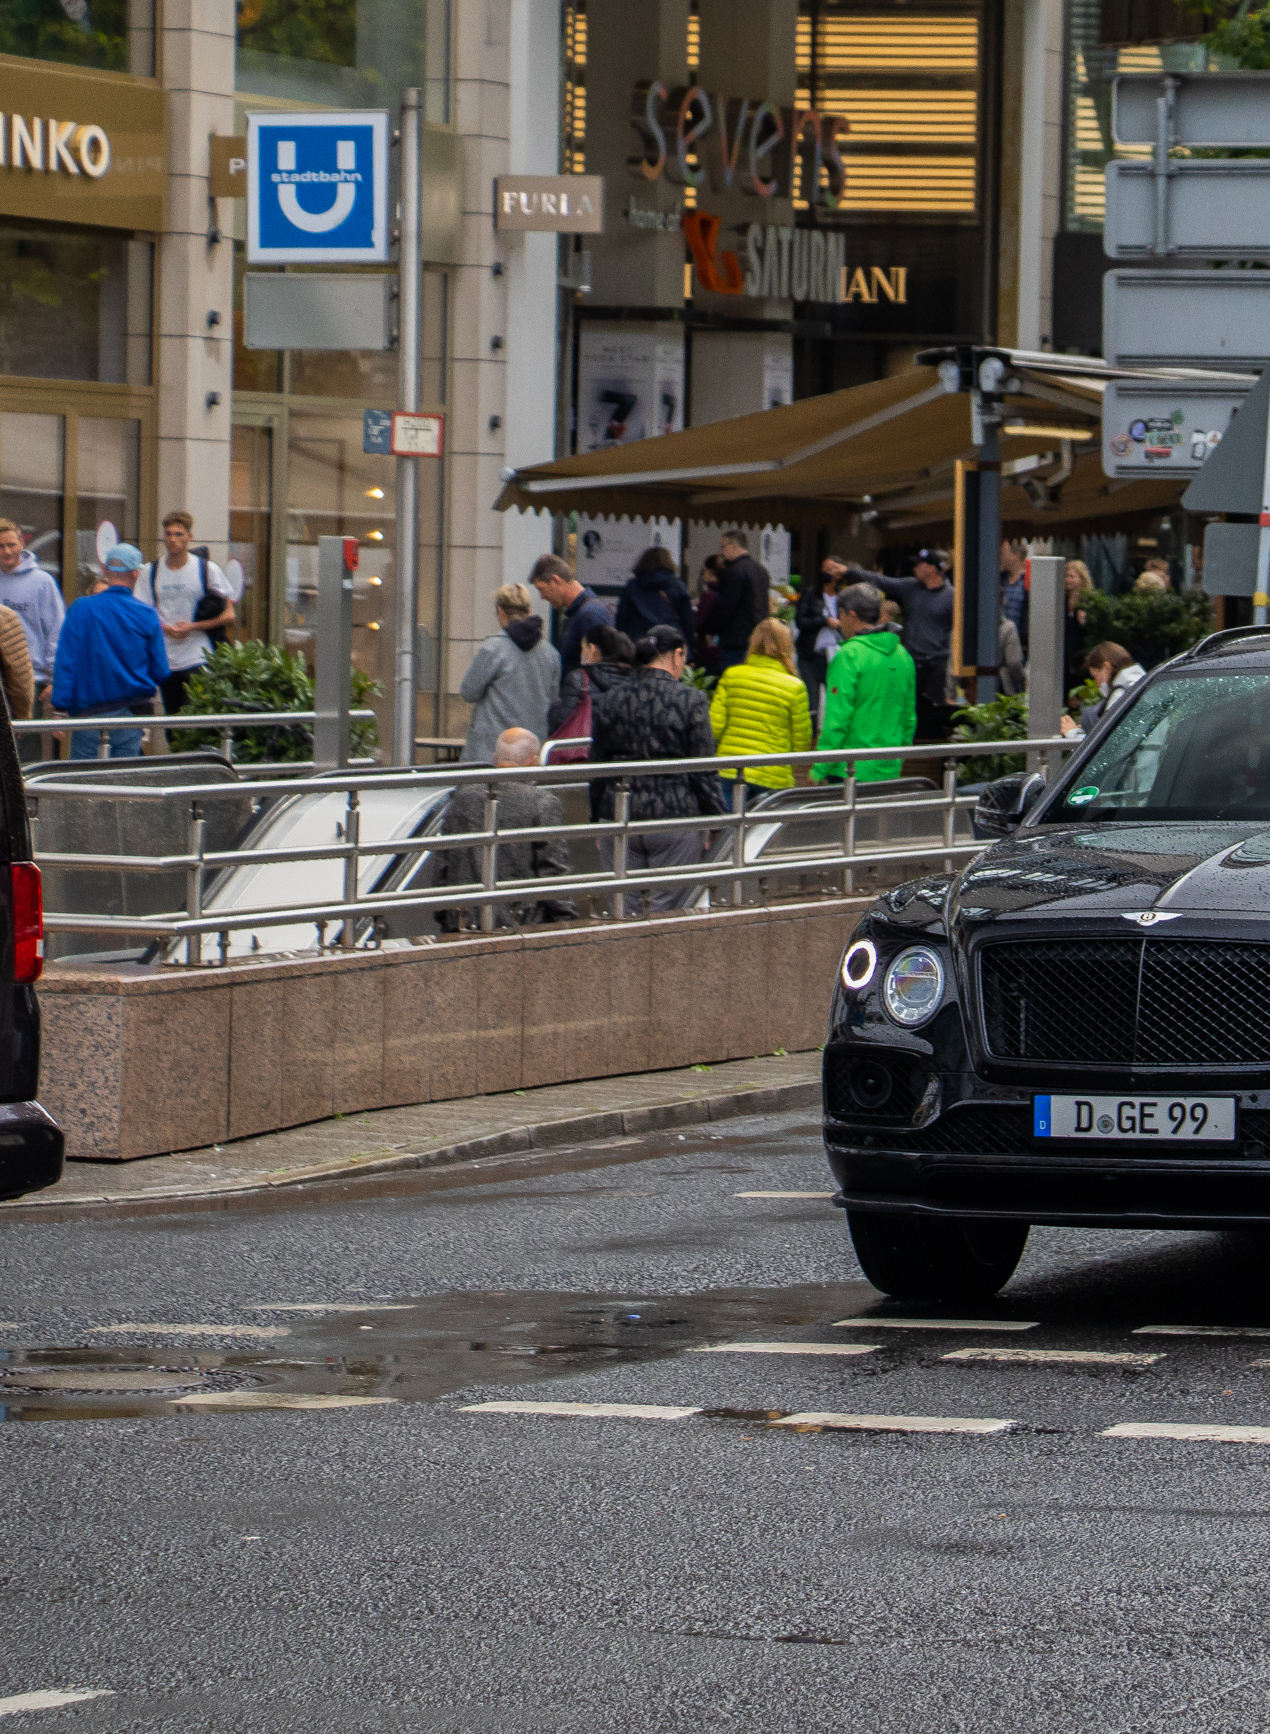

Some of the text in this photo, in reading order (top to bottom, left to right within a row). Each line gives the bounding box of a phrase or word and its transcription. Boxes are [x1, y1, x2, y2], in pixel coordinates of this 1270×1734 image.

[640, 82, 850, 210] sevens
[270, 170, 363, 183] stadtbahn
[745, 222, 846, 304] SATURN
[1038, 1119, 1047, 1131] D
[1074, 1100, 1210, 1136] D GE 99
